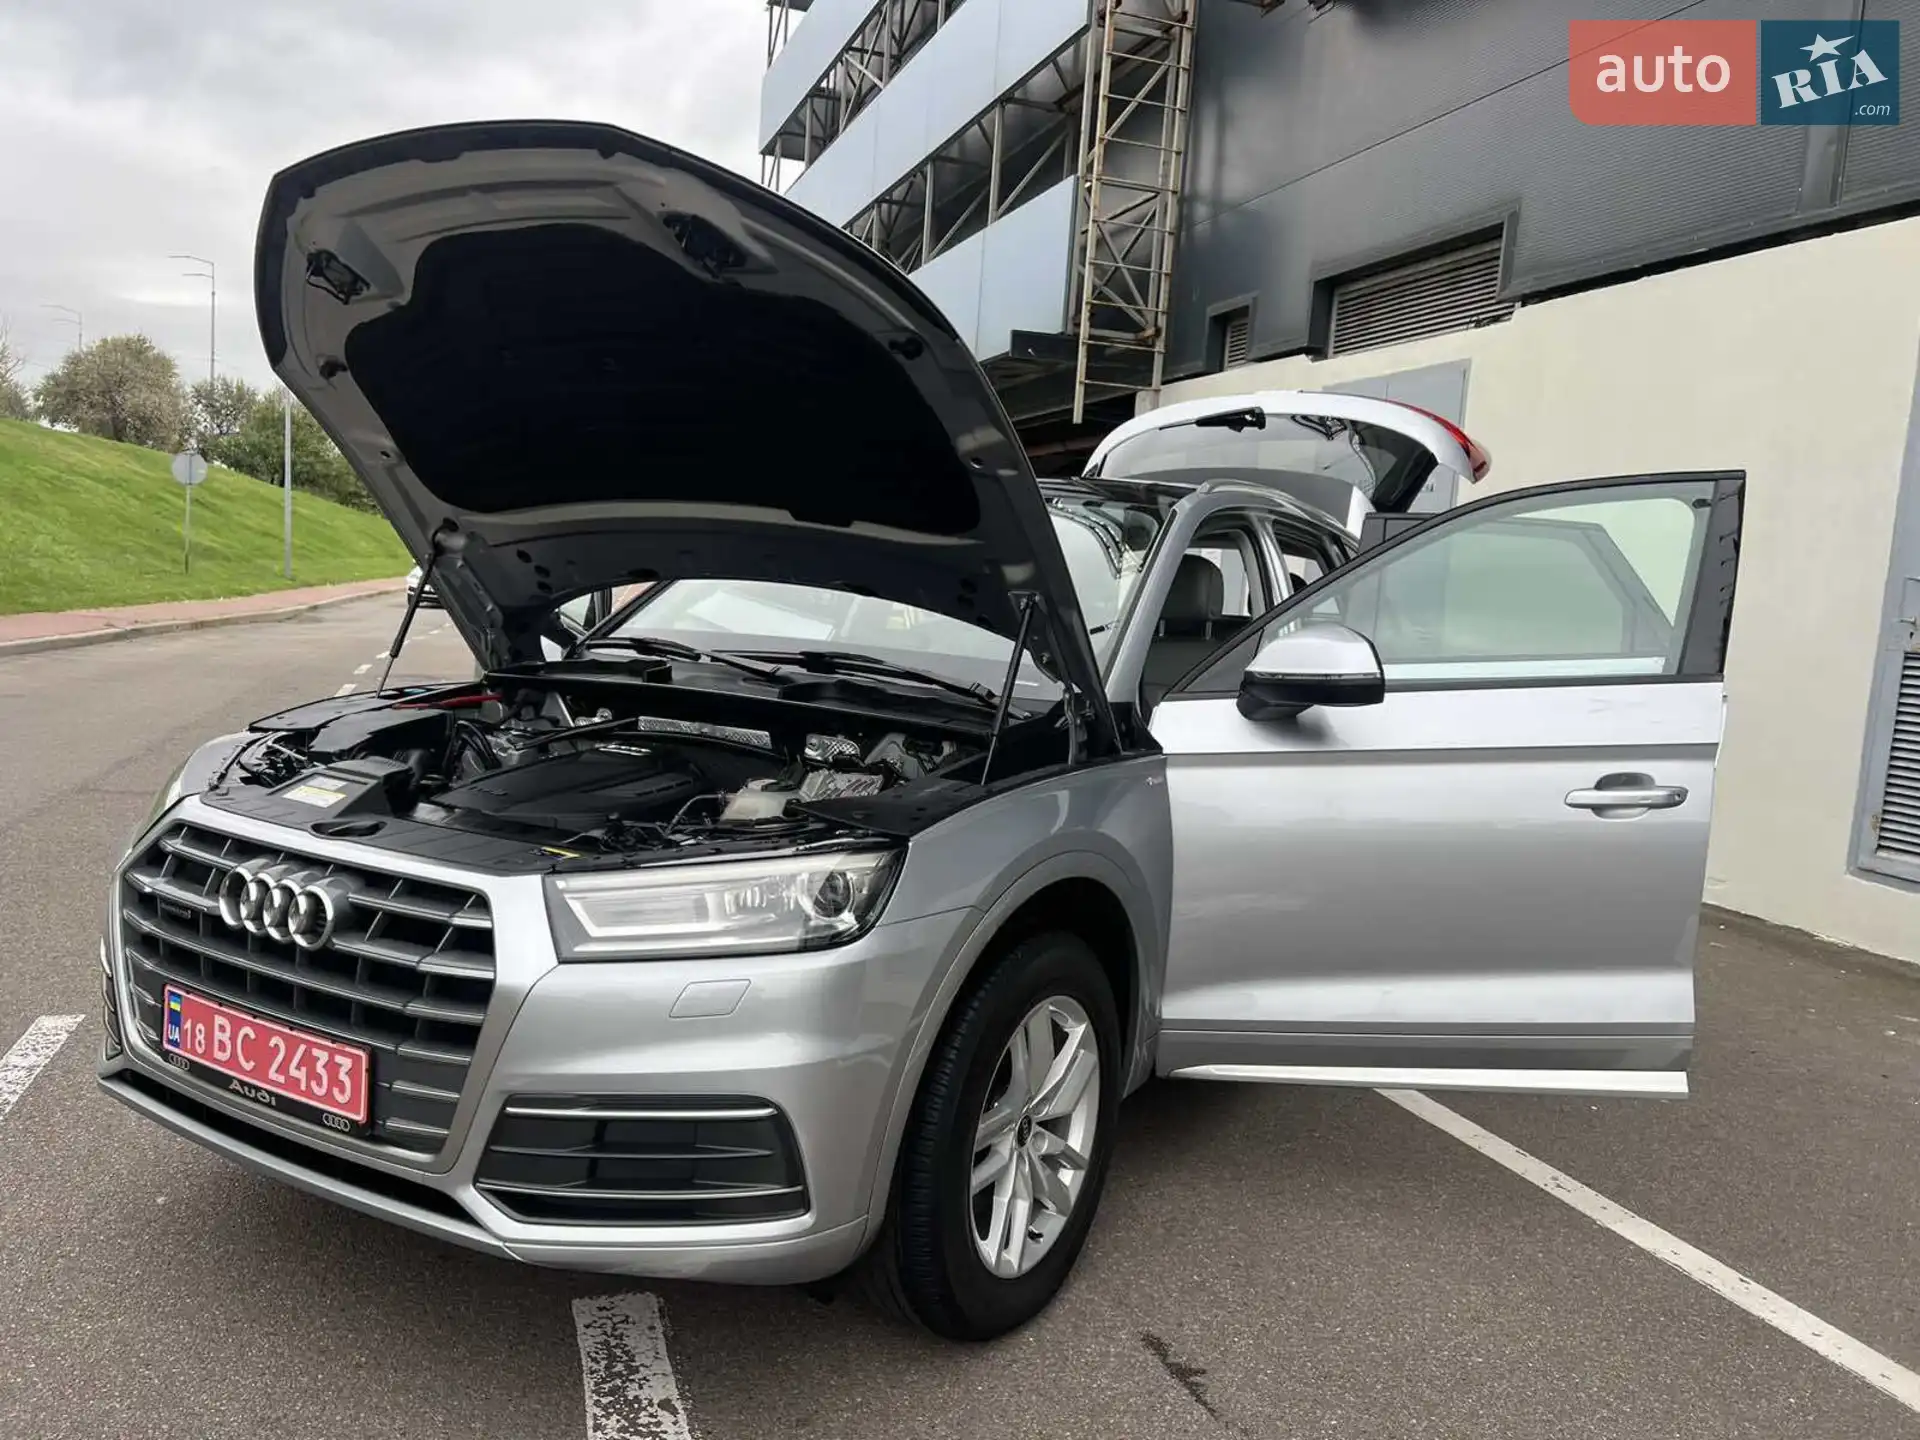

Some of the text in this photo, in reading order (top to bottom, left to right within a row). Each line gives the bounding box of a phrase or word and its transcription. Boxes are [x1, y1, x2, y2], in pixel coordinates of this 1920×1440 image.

[167, 1026, 180, 1044] UA
[184, 1014, 353, 1105] 18 BC 2433
[228, 1079, 277, 1107] Audi
